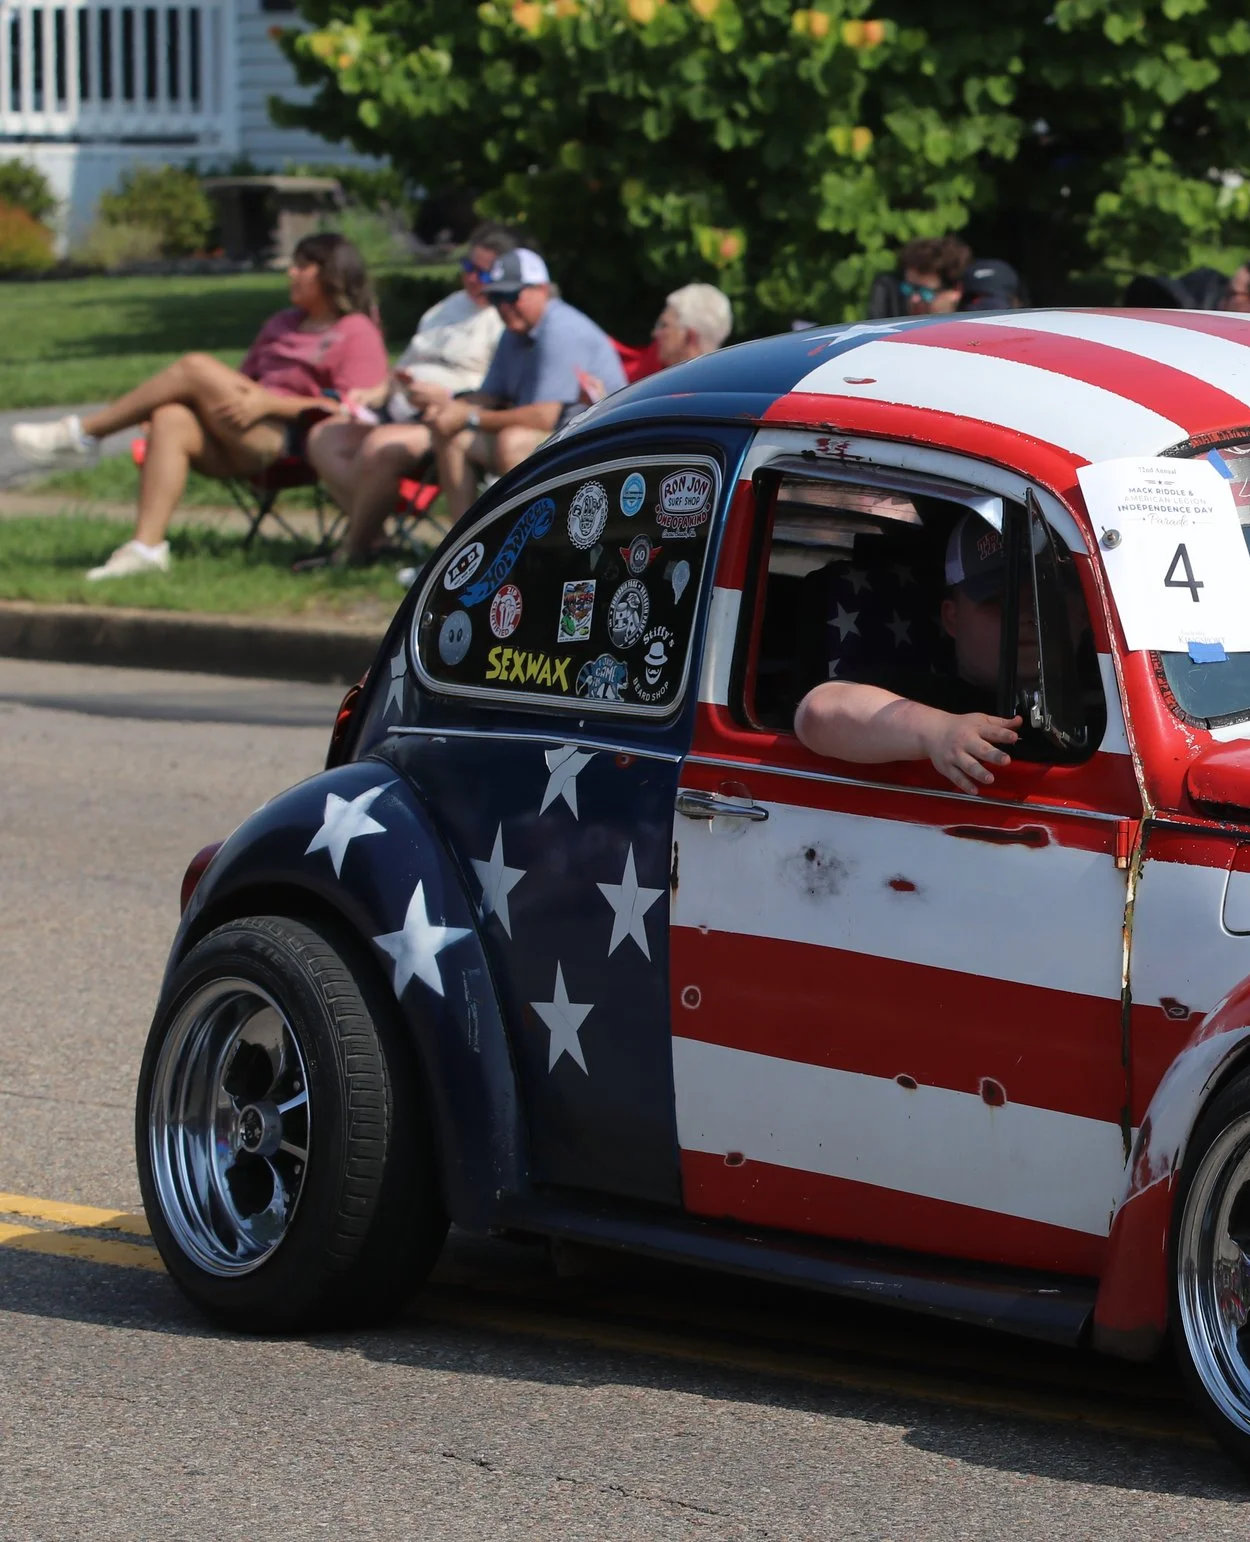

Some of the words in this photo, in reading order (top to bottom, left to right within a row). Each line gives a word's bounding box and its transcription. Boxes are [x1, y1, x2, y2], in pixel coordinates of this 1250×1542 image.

[1155, 467, 1177, 475] Annual
[664, 476, 686, 498] RON
[687, 477, 708, 495] JON
[1128, 487, 1153, 495] MACK
[1155, 488, 1186, 496] RIDDLE
[668, 497, 683, 507] SURF
[684, 496, 701, 506] SHOP
[1124, 495, 1171, 504] AMERICAN
[1173, 497, 1207, 506] LEGION
[1117, 503, 1191, 513] INDEPENDENCE
[657, 512, 672, 527] ONE
[672, 516, 683, 529] OF
[689, 512, 708, 527] KIND
[1147, 513, 1189, 527] Parade
[634, 550, 645, 561] 60
[1164, 543, 1204, 602] 4
[507, 586, 518, 596] ZIP
[491, 601, 510, 637] CERTIFIED
[643, 625, 675, 648] Stiffy's
[485, 645, 572, 692] SEXWAX
[632, 677, 651, 702] BEARD
[651, 681, 669, 701] SHOP
